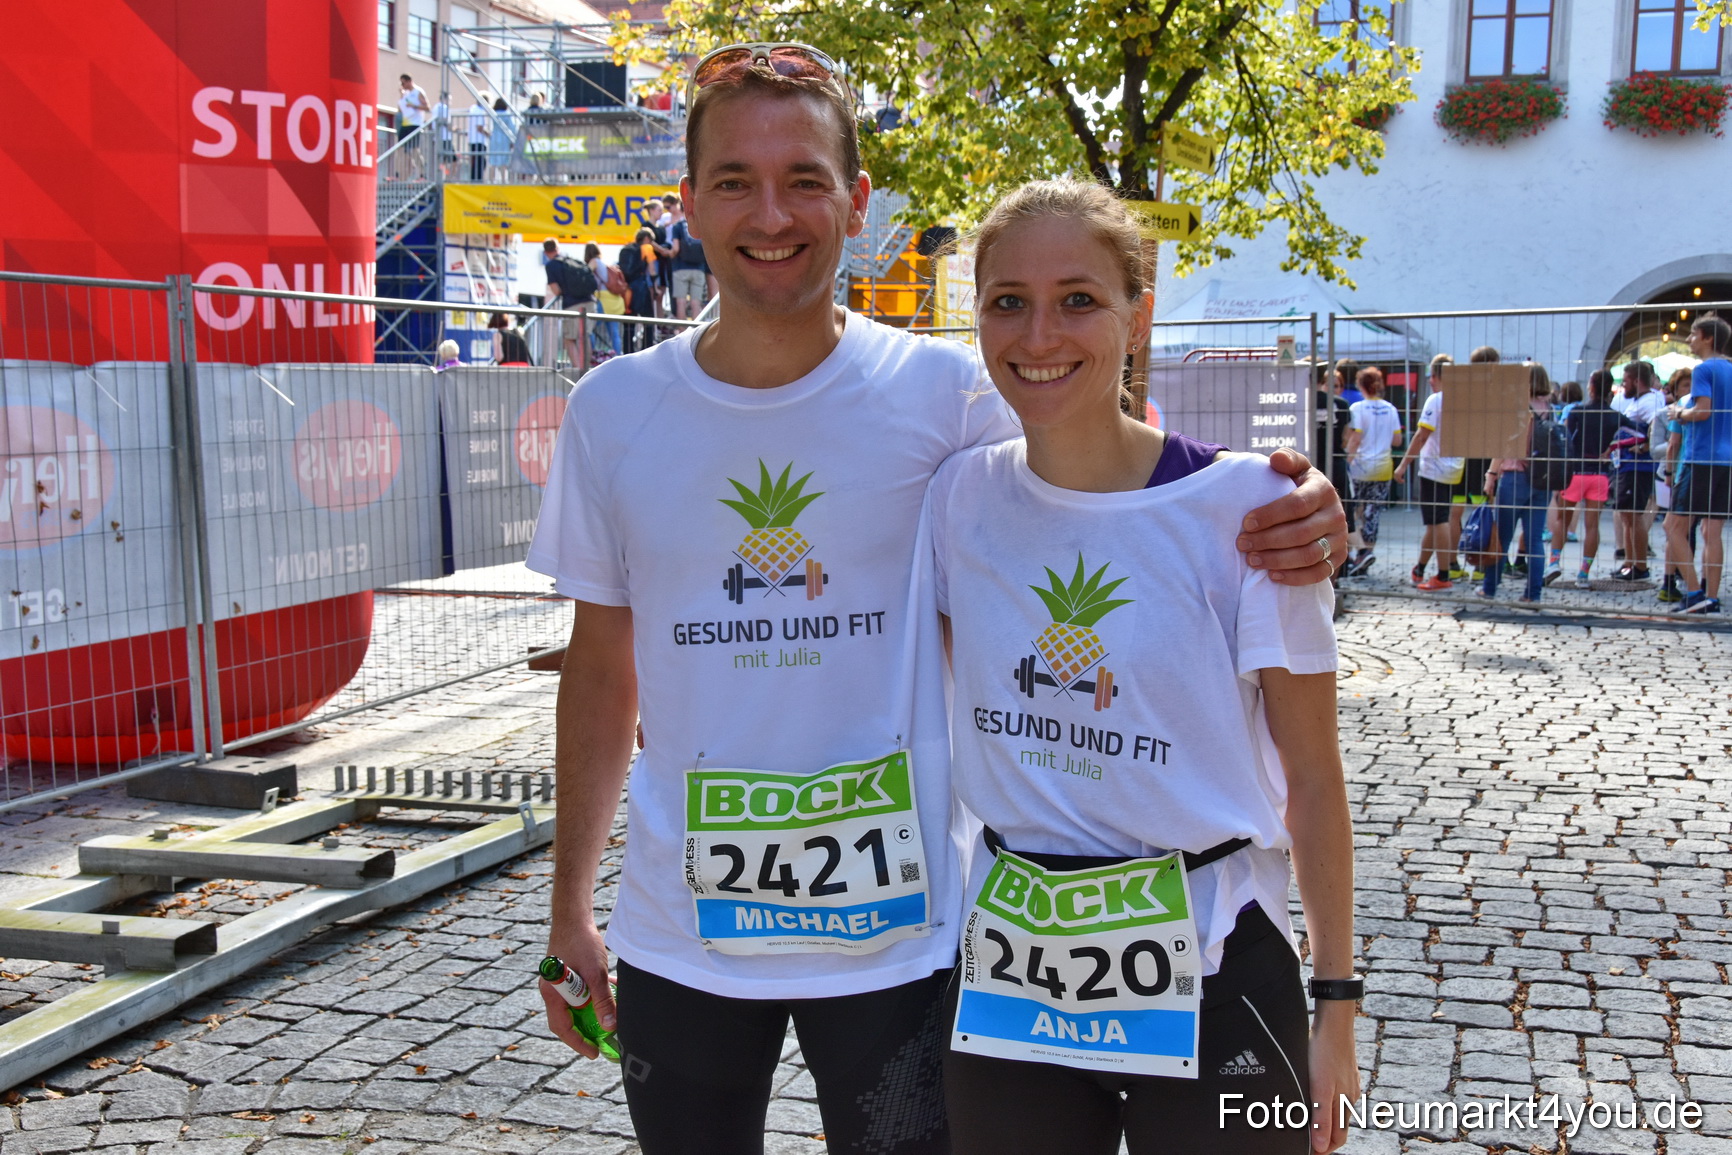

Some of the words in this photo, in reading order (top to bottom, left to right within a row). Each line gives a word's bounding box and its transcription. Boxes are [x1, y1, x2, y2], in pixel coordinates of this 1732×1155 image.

[192, 86, 374, 168] STORE
[1137, 212, 1180, 231] etten
[673, 618, 773, 646] GESUND
[782, 615, 839, 641] UND
[848, 610, 886, 637] FIT
[734, 649, 769, 669] mit
[775, 647, 821, 668] Julia
[974, 707, 1062, 743] GESUND
[1070, 723, 1124, 757] UND
[1133, 735, 1172, 765] FIT
[1020, 748, 1057, 770] mit
[1062, 753, 1103, 781] Julia
[702, 765, 893, 822] BOCK
[898, 828, 910, 840] C
[710, 828, 891, 898] 2421
[989, 864, 1168, 926] BOCK
[736, 906, 889, 936] MICHAEL
[1174, 940, 1186, 952] D
[984, 927, 1172, 1001] 2420
[1030, 1011, 1129, 1045] ANJA
[1218, 1065, 1266, 1075] adidas
